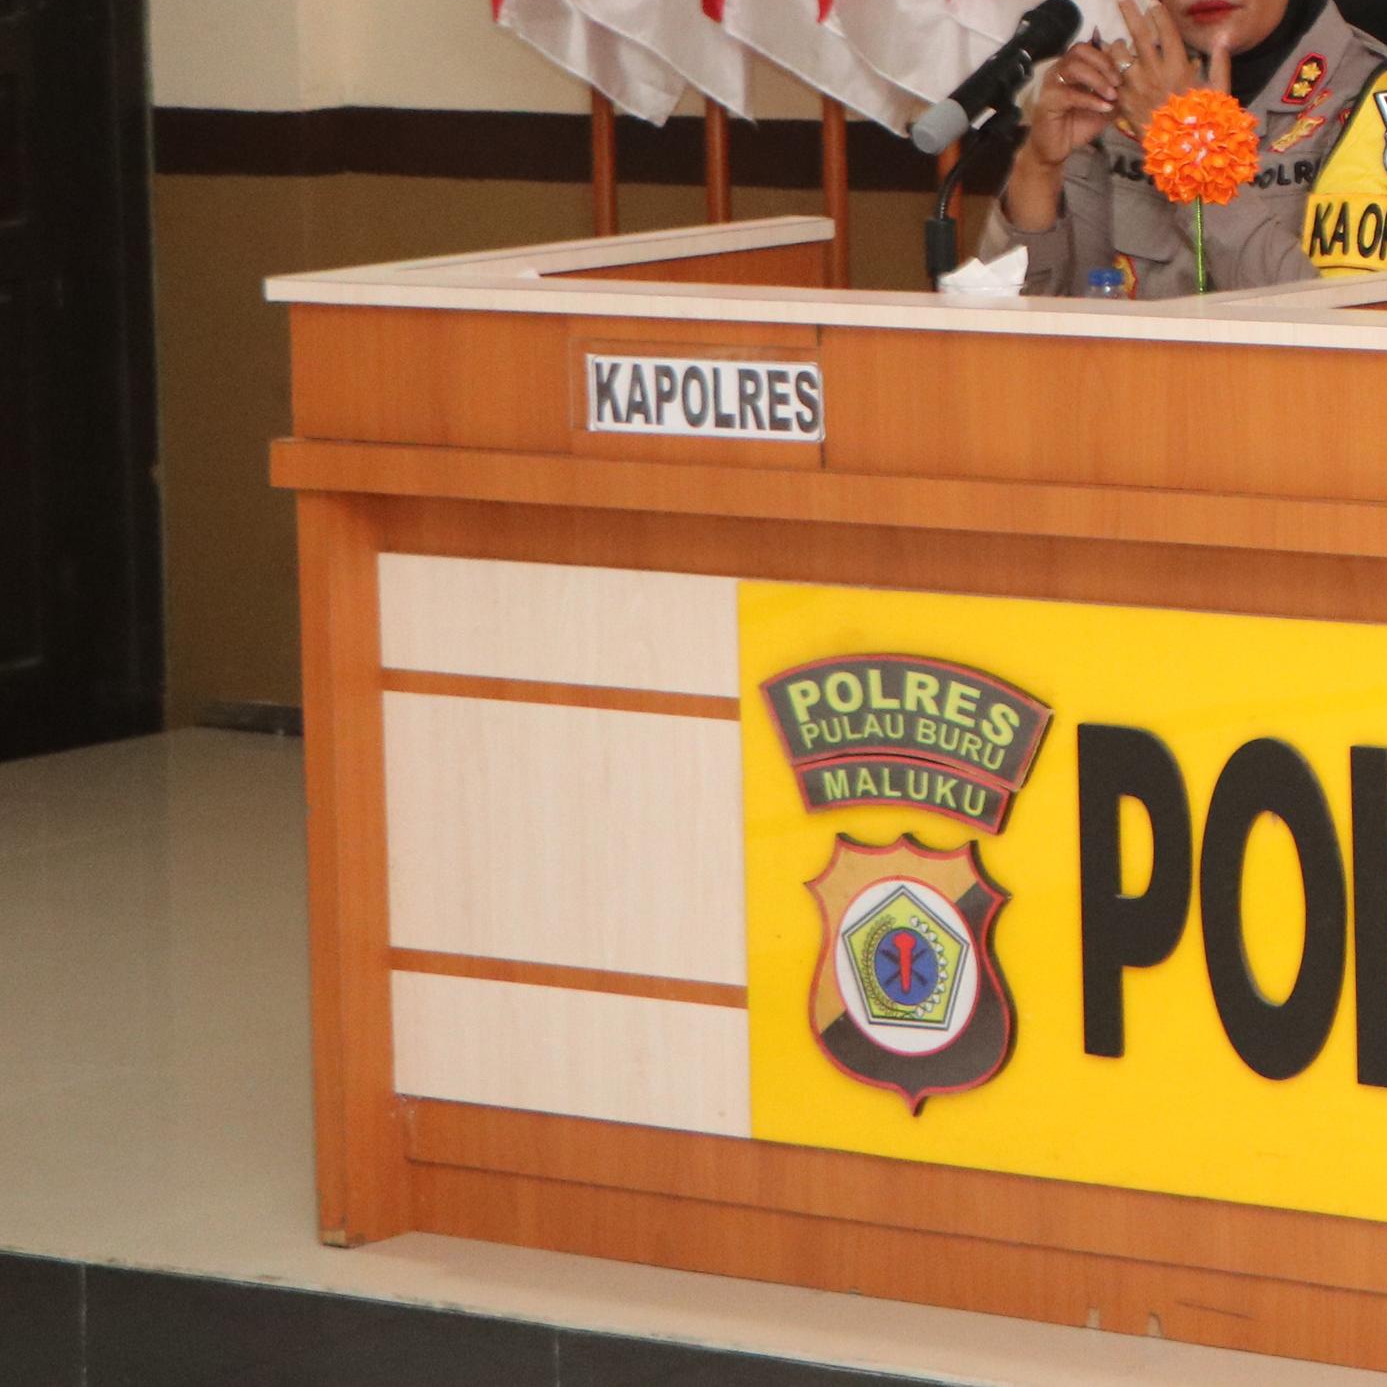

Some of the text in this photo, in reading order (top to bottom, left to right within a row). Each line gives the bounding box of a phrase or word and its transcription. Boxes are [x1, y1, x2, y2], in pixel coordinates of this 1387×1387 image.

[1309, 201, 1350, 259] KA
[595, 361, 820, 434] KAPOLRES
[787, 669, 1022, 749] POLRES
[801, 712, 1006, 771] PULAU BURU
[822, 766, 987, 817] MALUKU
